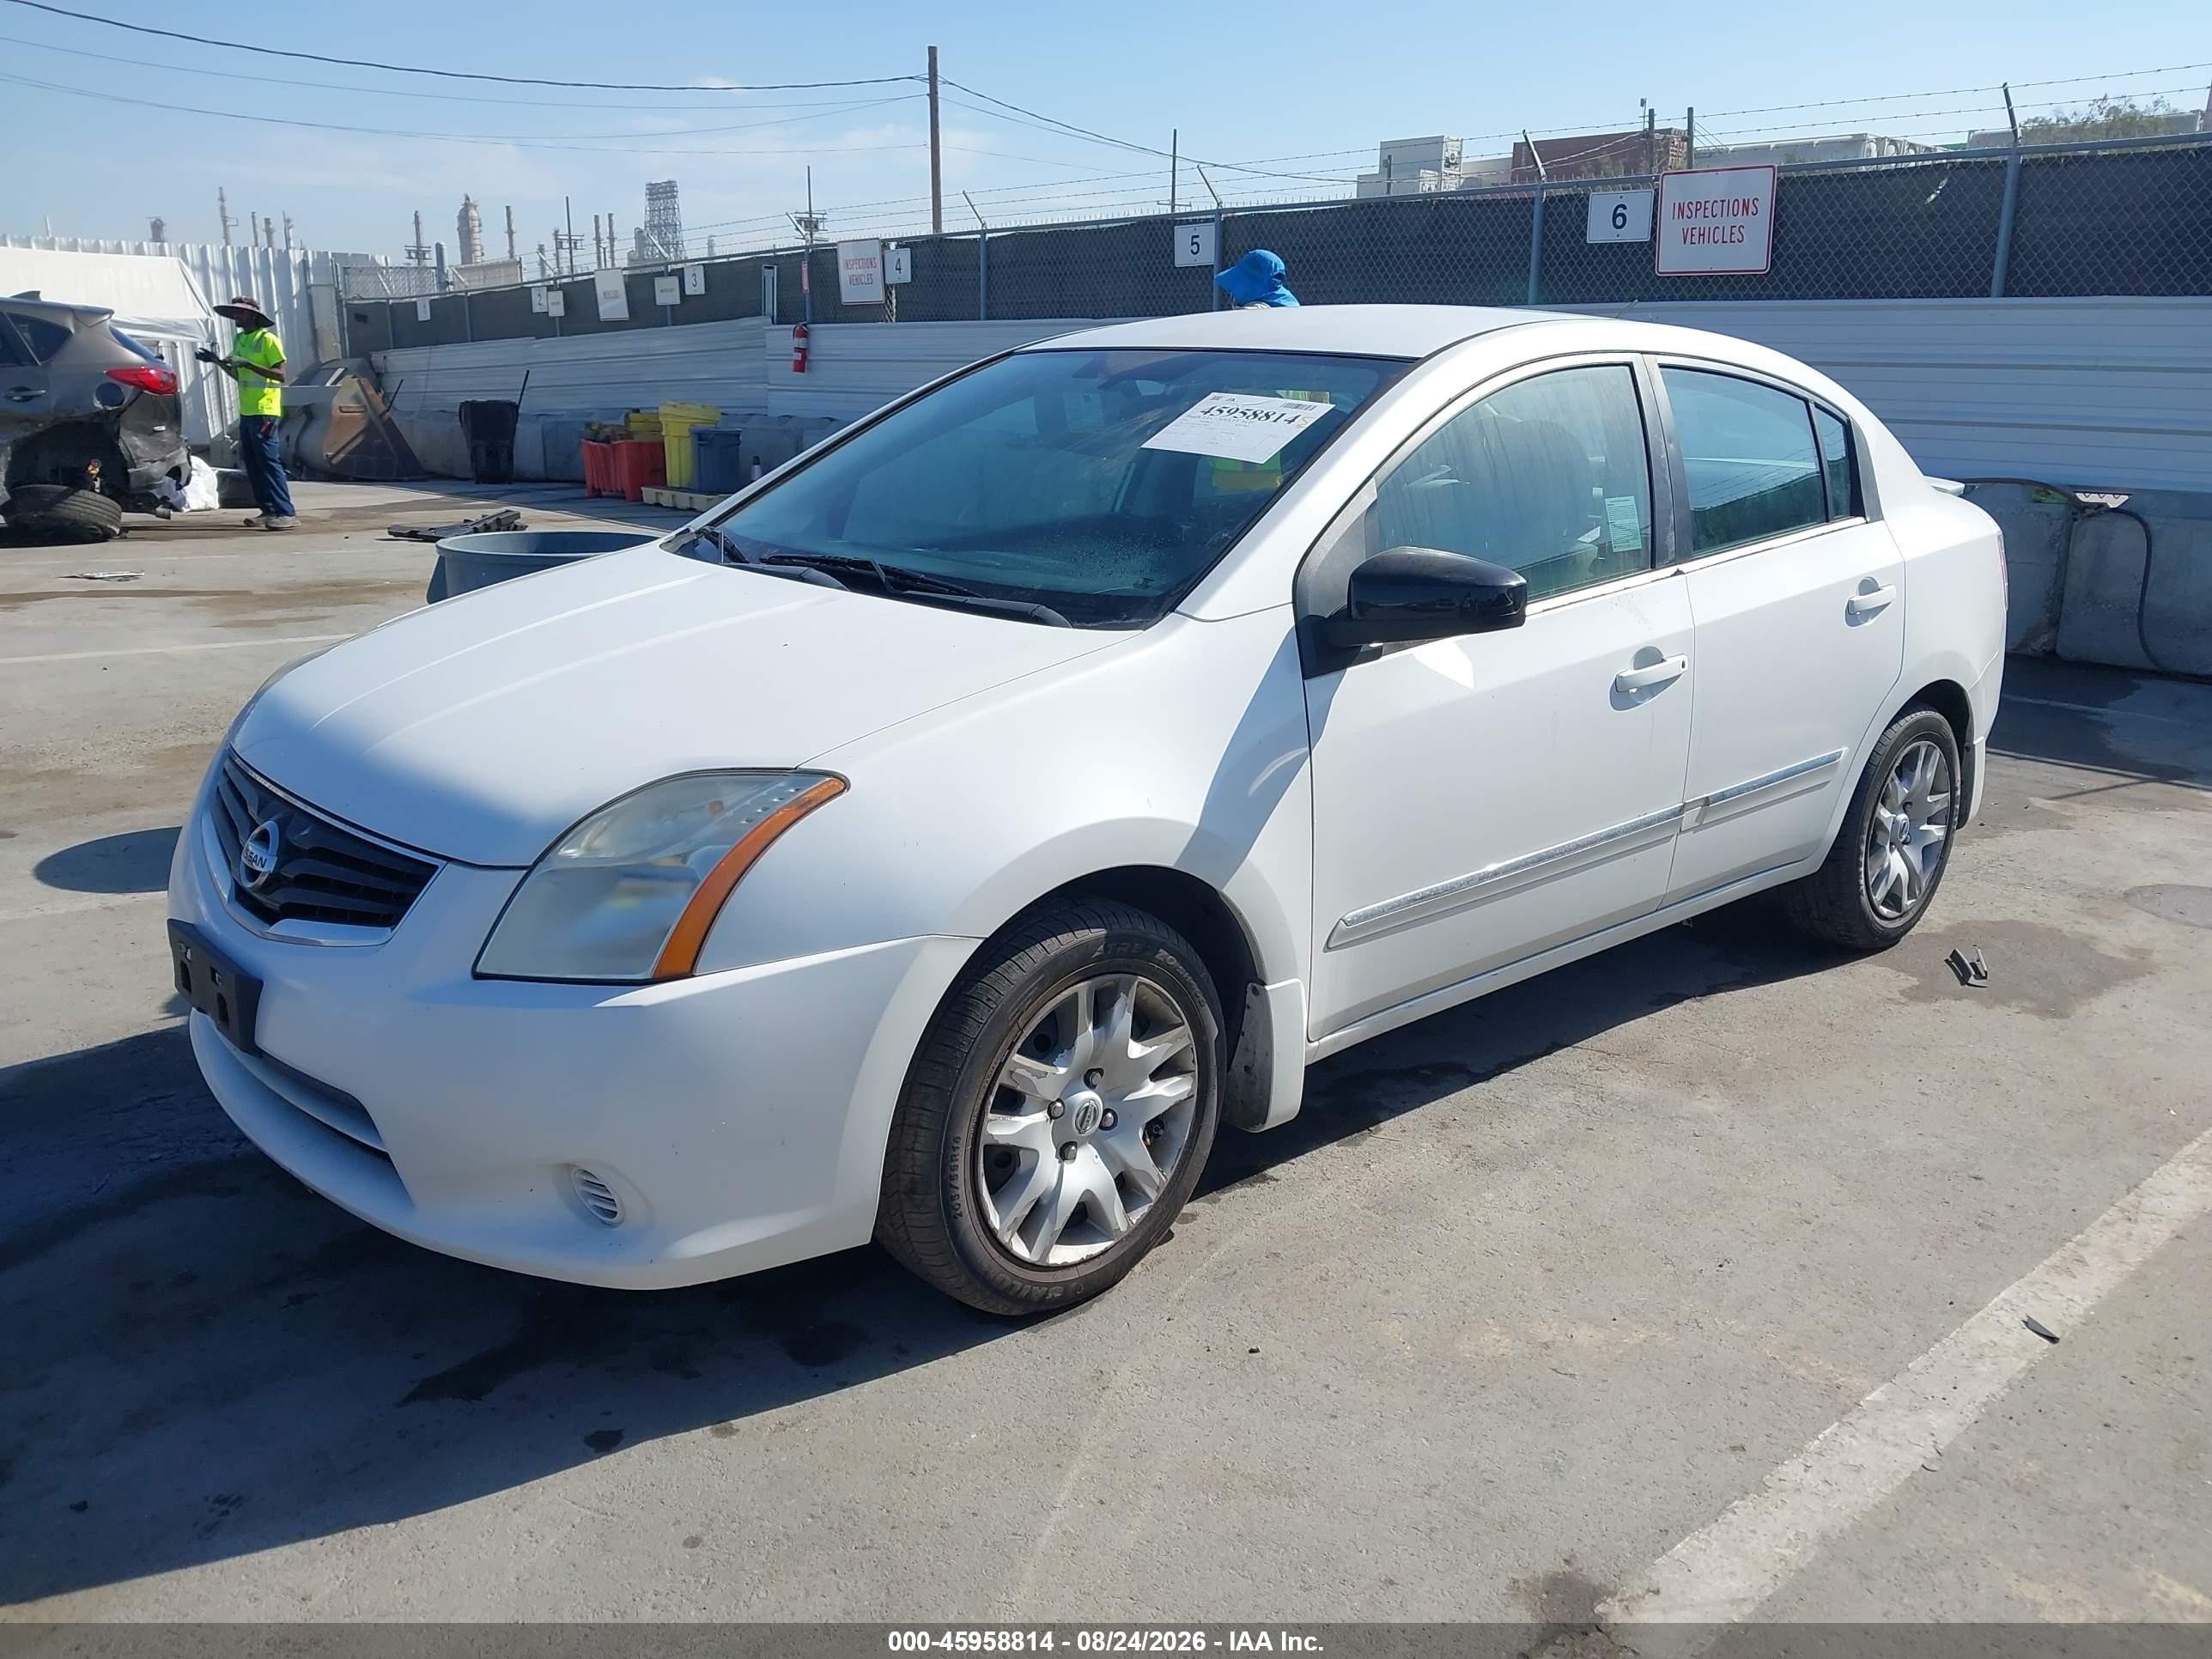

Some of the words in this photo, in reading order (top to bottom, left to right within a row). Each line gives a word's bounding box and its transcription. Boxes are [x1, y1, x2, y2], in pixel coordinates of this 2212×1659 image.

[1612, 204, 1627, 229] 6
[1672, 198, 1759, 221] INSPECTIONS
[1681, 224, 1745, 246] VEHICLES
[1190, 234, 1200, 255] 5
[843, 257, 878, 271] INSPECTIONS
[895, 258, 902, 274] 4
[691, 272, 697, 288] 3
[848, 273, 873, 286] VEHICLES
[537, 293, 543, 307] 2
[1200, 405, 1302, 425] 45958814
